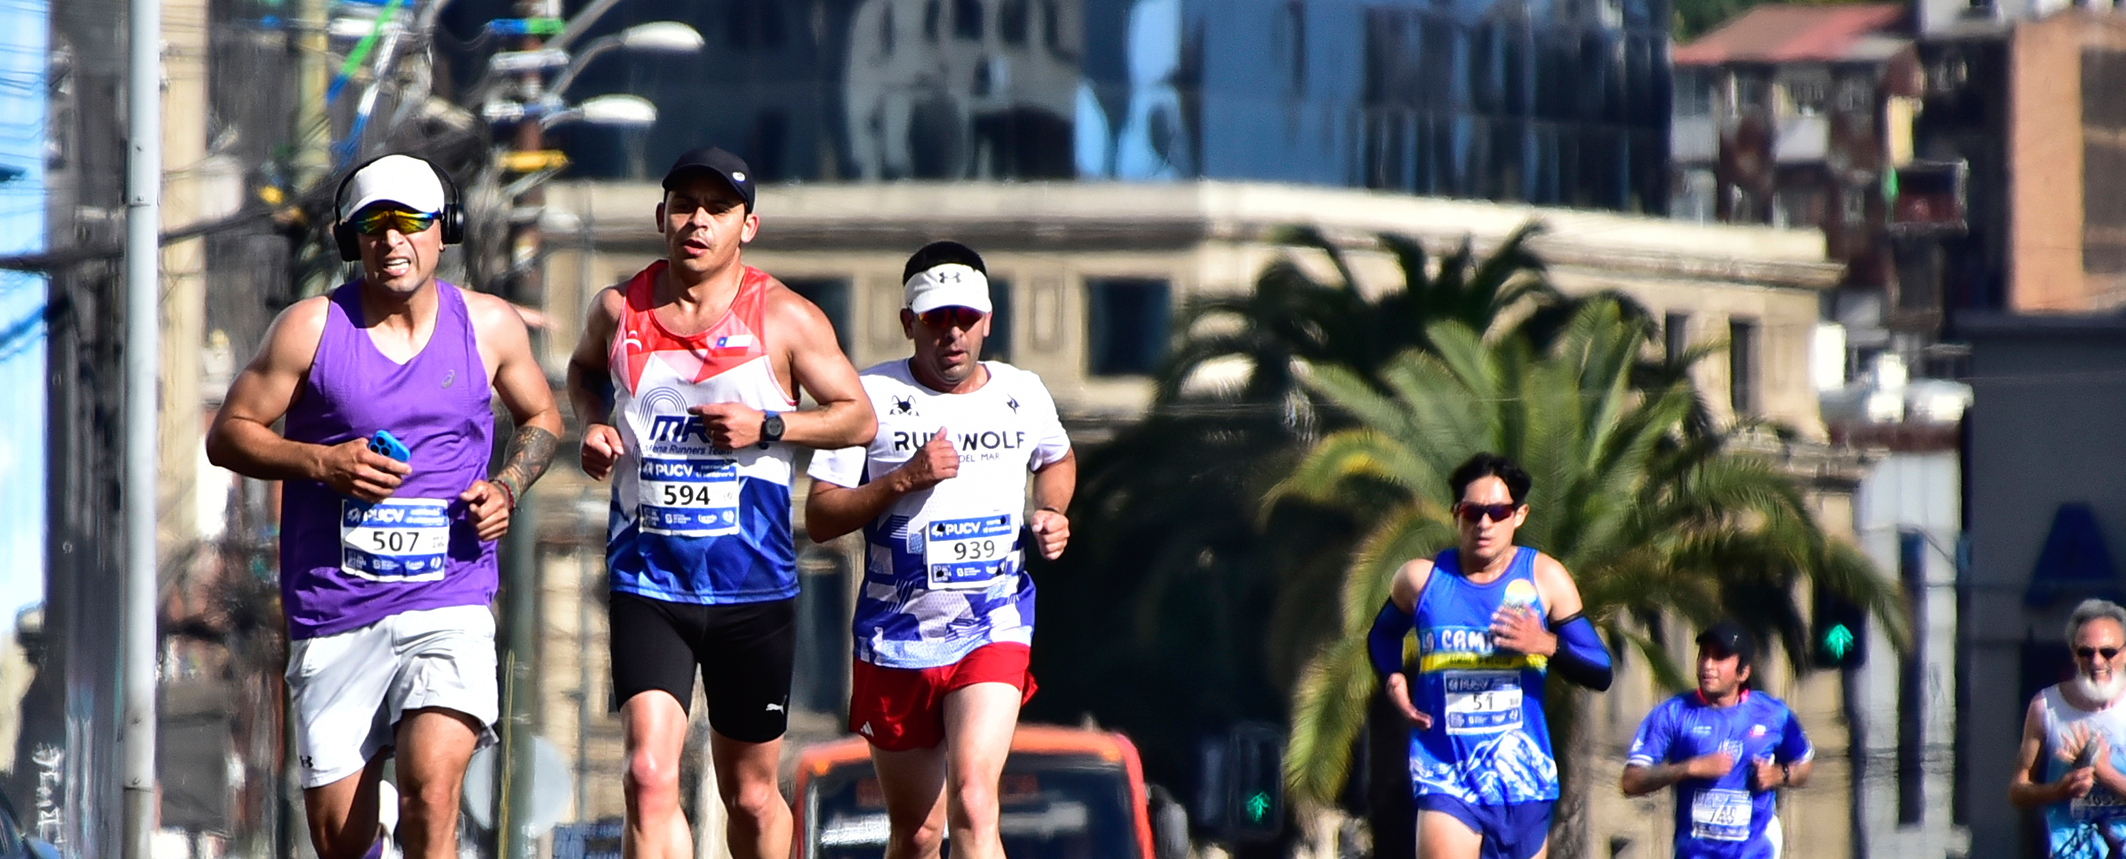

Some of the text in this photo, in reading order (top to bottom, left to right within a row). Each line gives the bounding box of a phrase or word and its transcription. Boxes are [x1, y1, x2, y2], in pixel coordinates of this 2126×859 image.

[669, 444, 706, 455] Runners
[959, 452, 1000, 463] DEL MAR
[655, 463, 693, 477] PUCV
[663, 484, 710, 505] 594
[363, 508, 405, 523] PUCV
[945, 521, 981, 535] PUCV
[373, 531, 420, 552] 507
[954, 540, 995, 560] 939
[1473, 692, 1494, 710] 51
